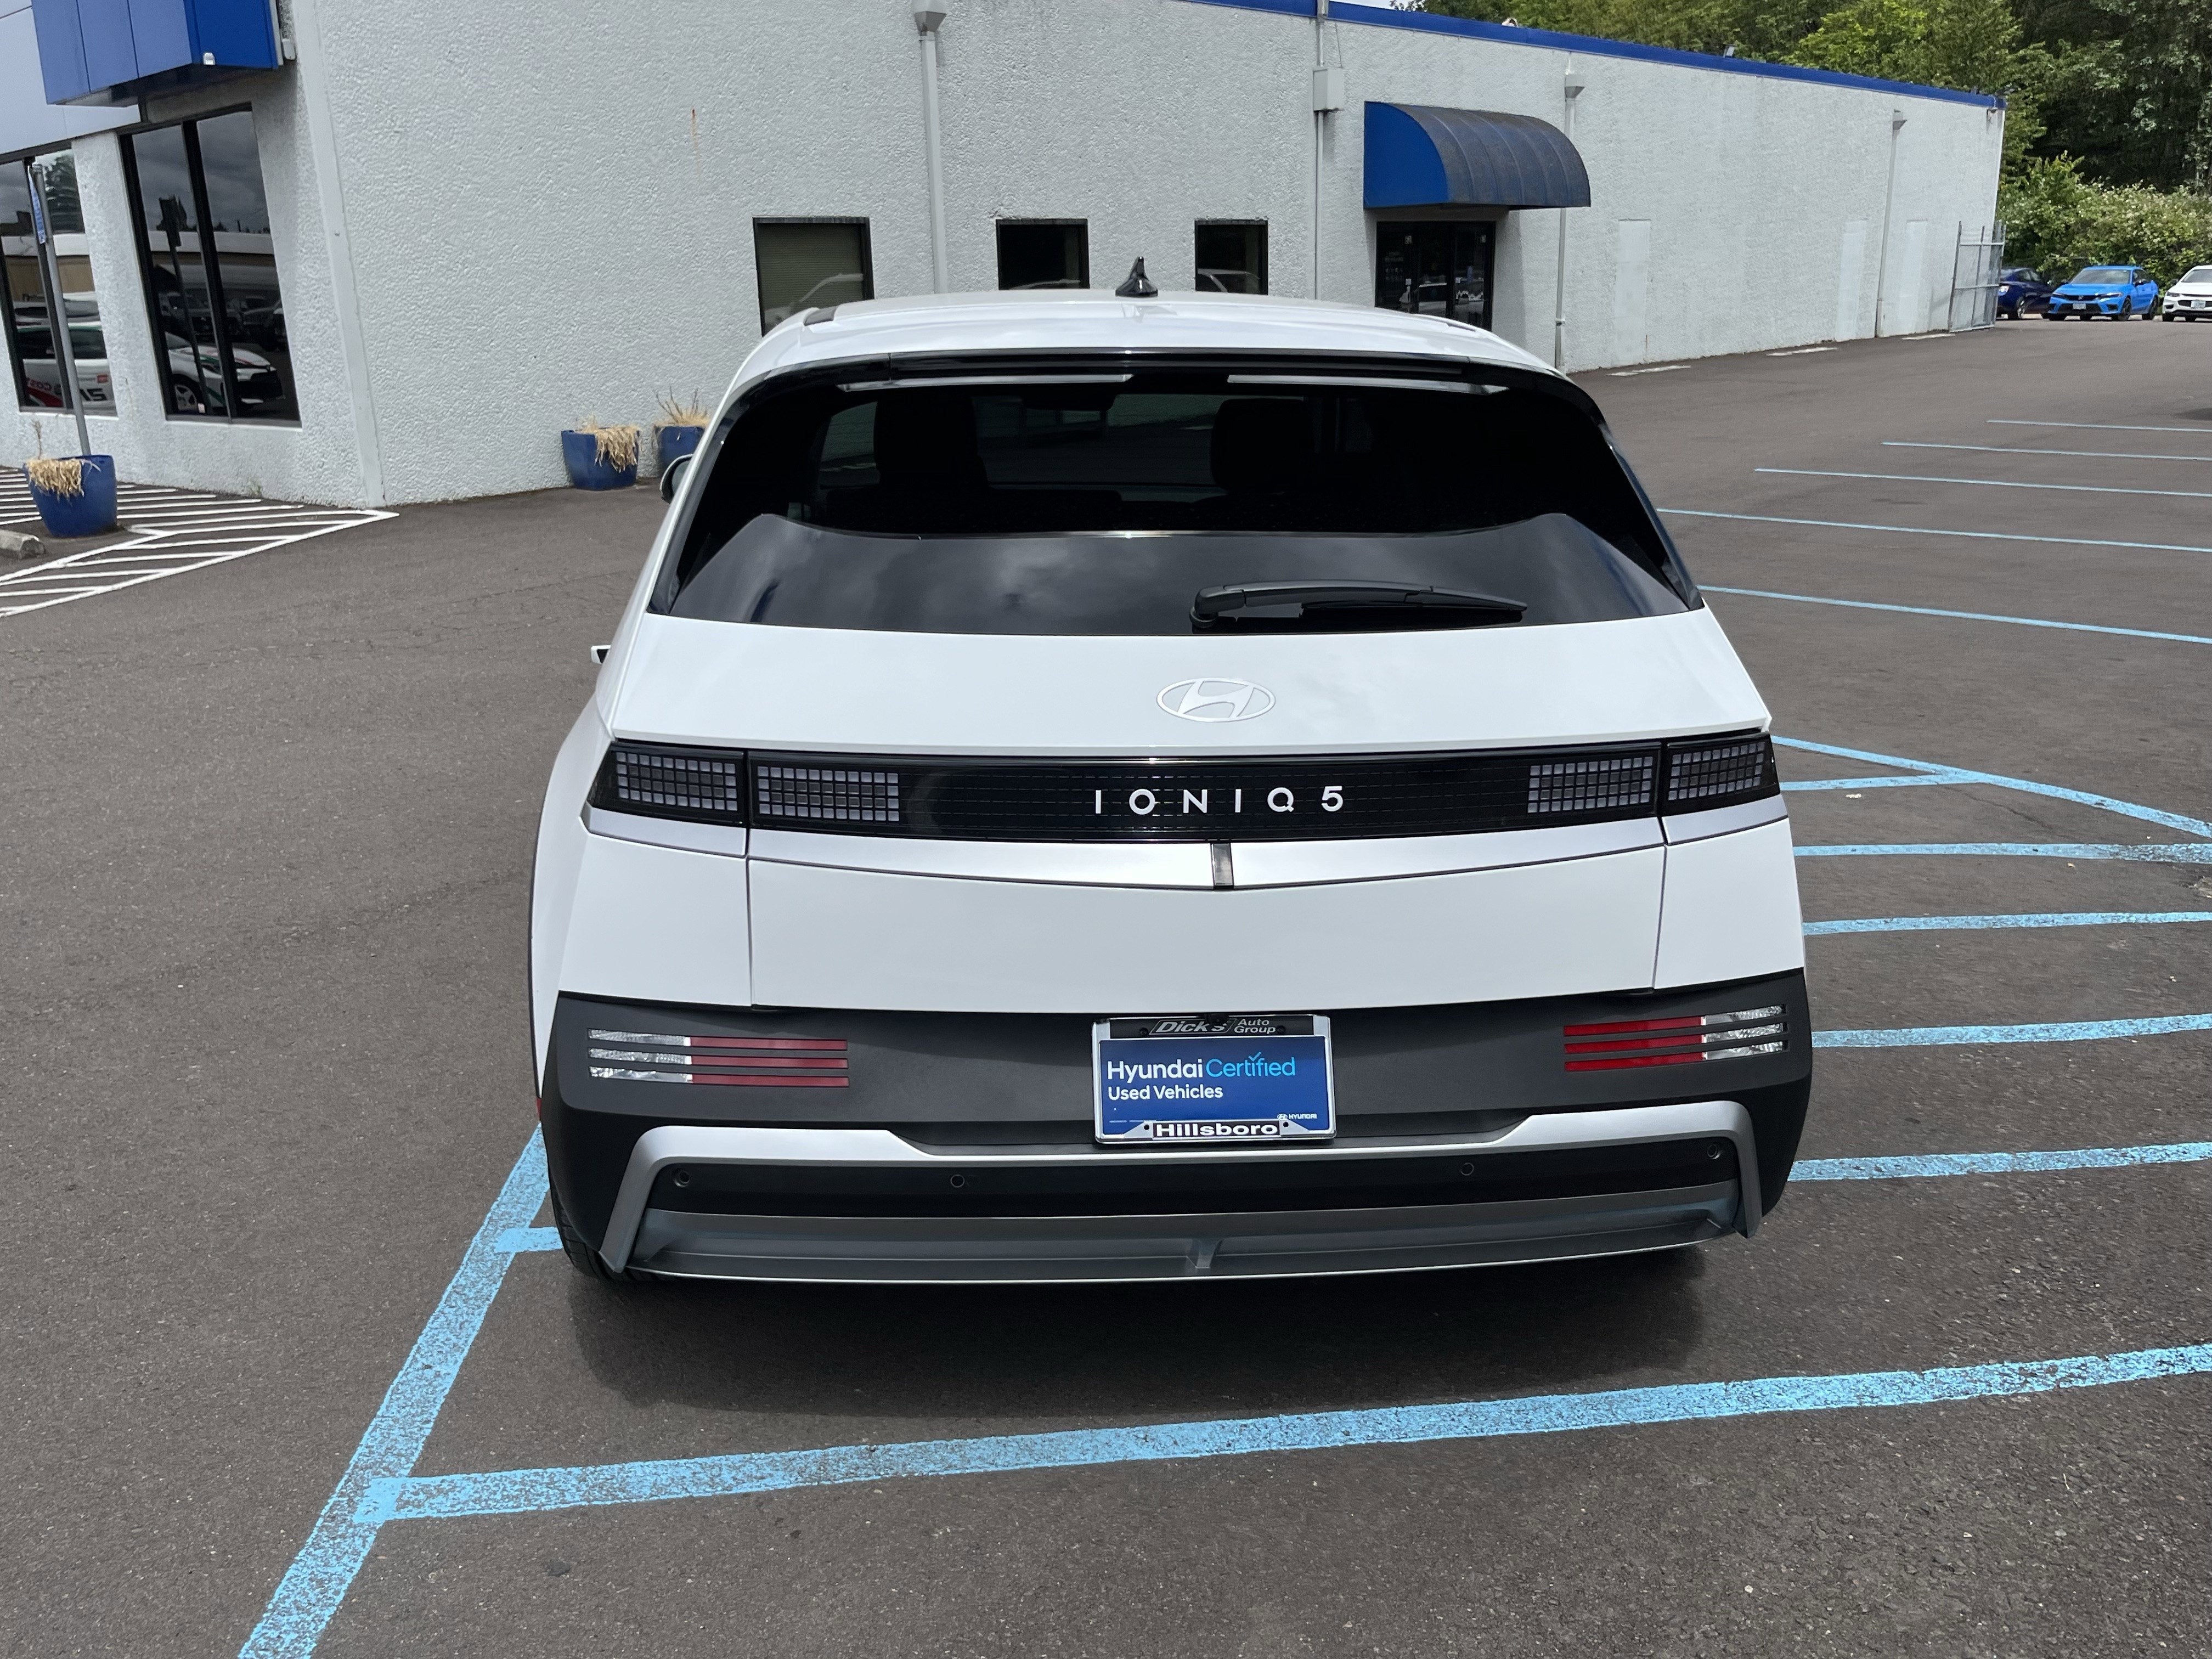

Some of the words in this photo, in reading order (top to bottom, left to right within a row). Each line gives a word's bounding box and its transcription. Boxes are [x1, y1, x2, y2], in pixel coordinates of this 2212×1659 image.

[1095, 787, 1294, 815] IONIQ
[1321, 786, 1343, 812] 5
[1234, 1025, 1276, 1034] Group
[1107, 1058, 1203, 1084] Hyundai
[1206, 1052, 1296, 1077] Certified
[1108, 1085, 1151, 1101] Used
[1153, 1084, 1223, 1099] Vehicles
[1156, 1123, 1278, 1137] Hillsboro
